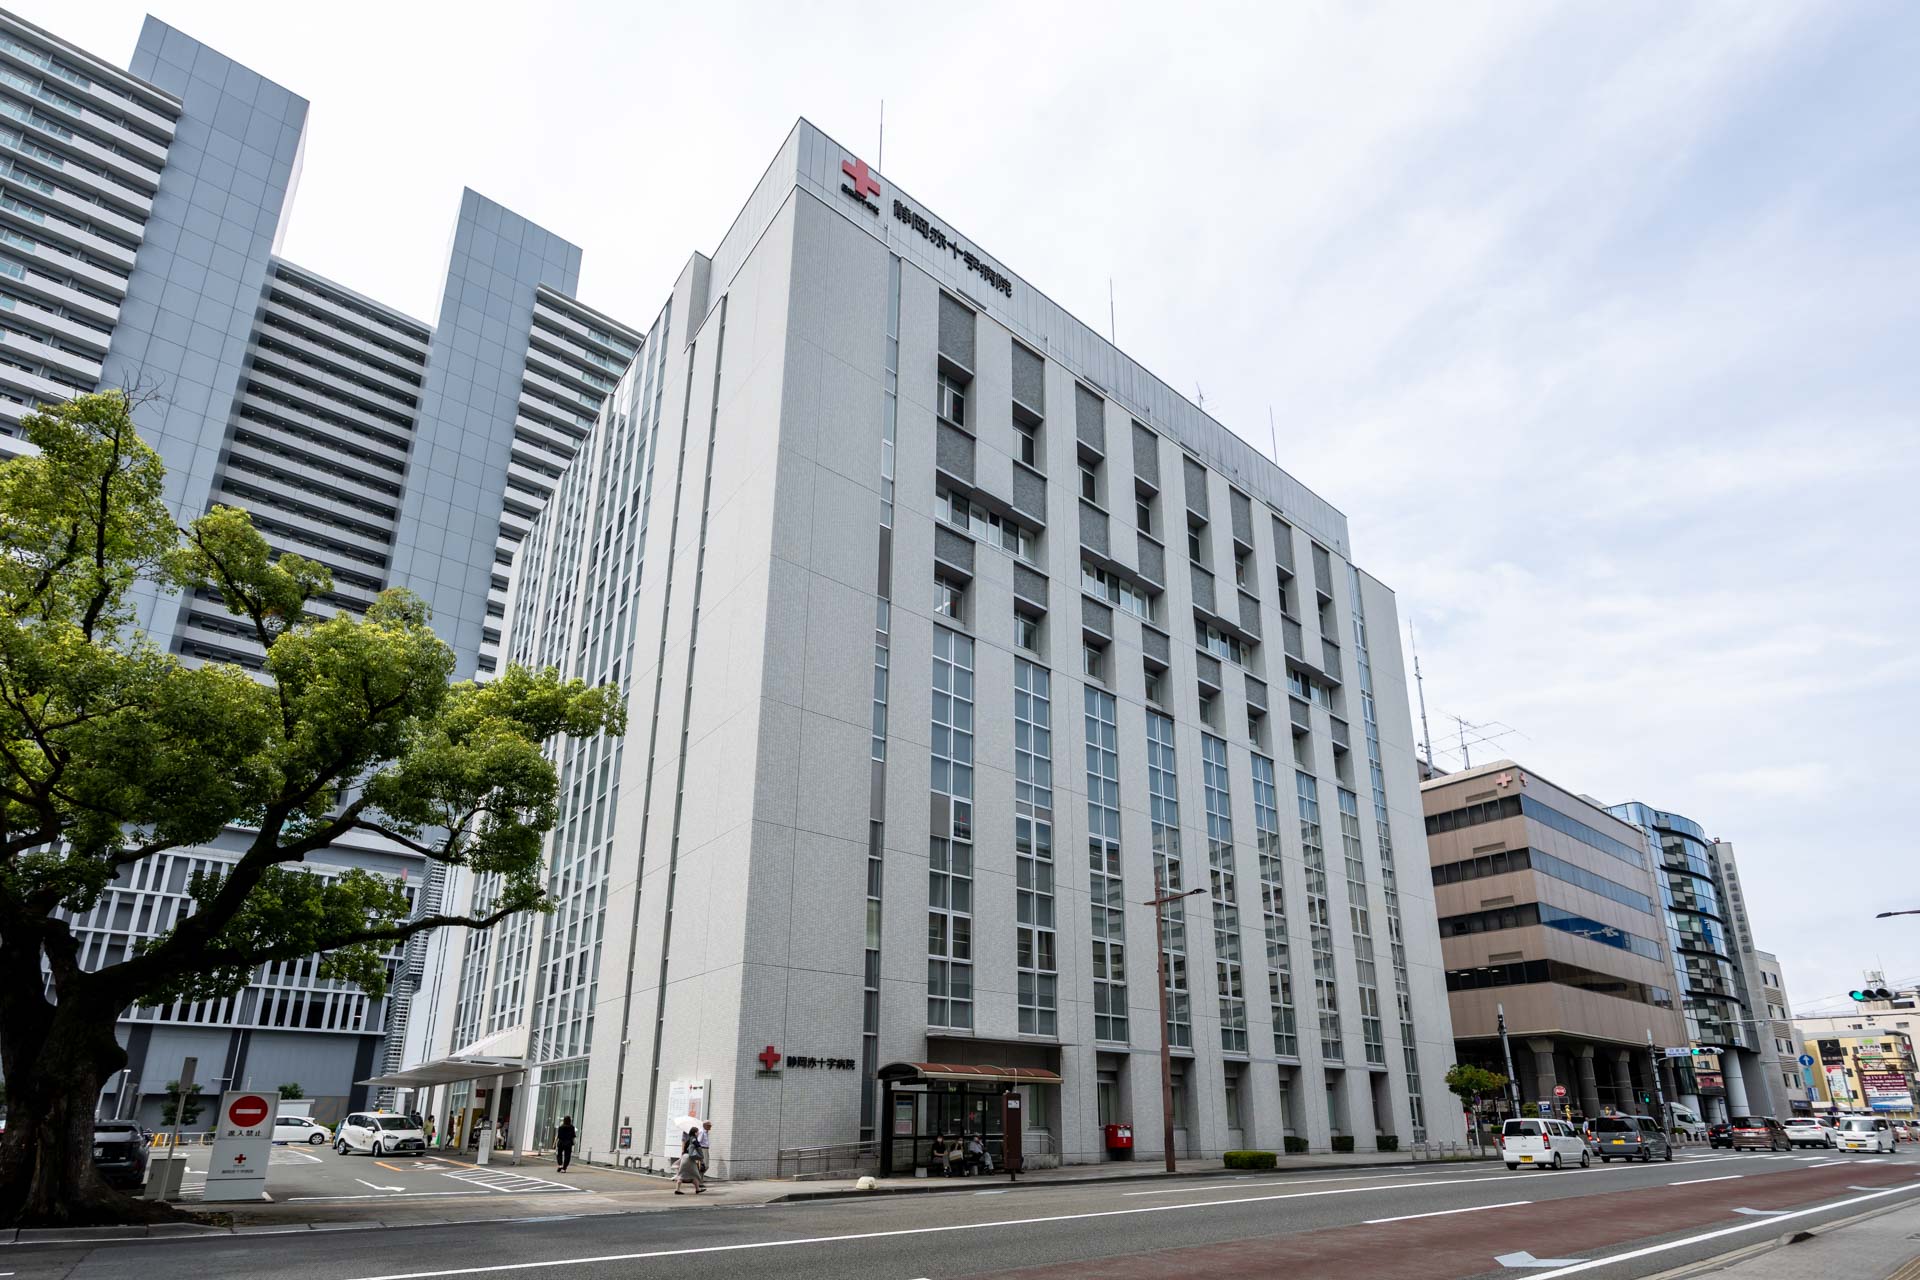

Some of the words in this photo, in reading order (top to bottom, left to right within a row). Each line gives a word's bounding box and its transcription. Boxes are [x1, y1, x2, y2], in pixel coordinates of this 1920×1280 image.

[893, 199, 1012, 298] 静岡赤十字病院
[786, 1056, 855, 1070] 静岡赤十字病院
